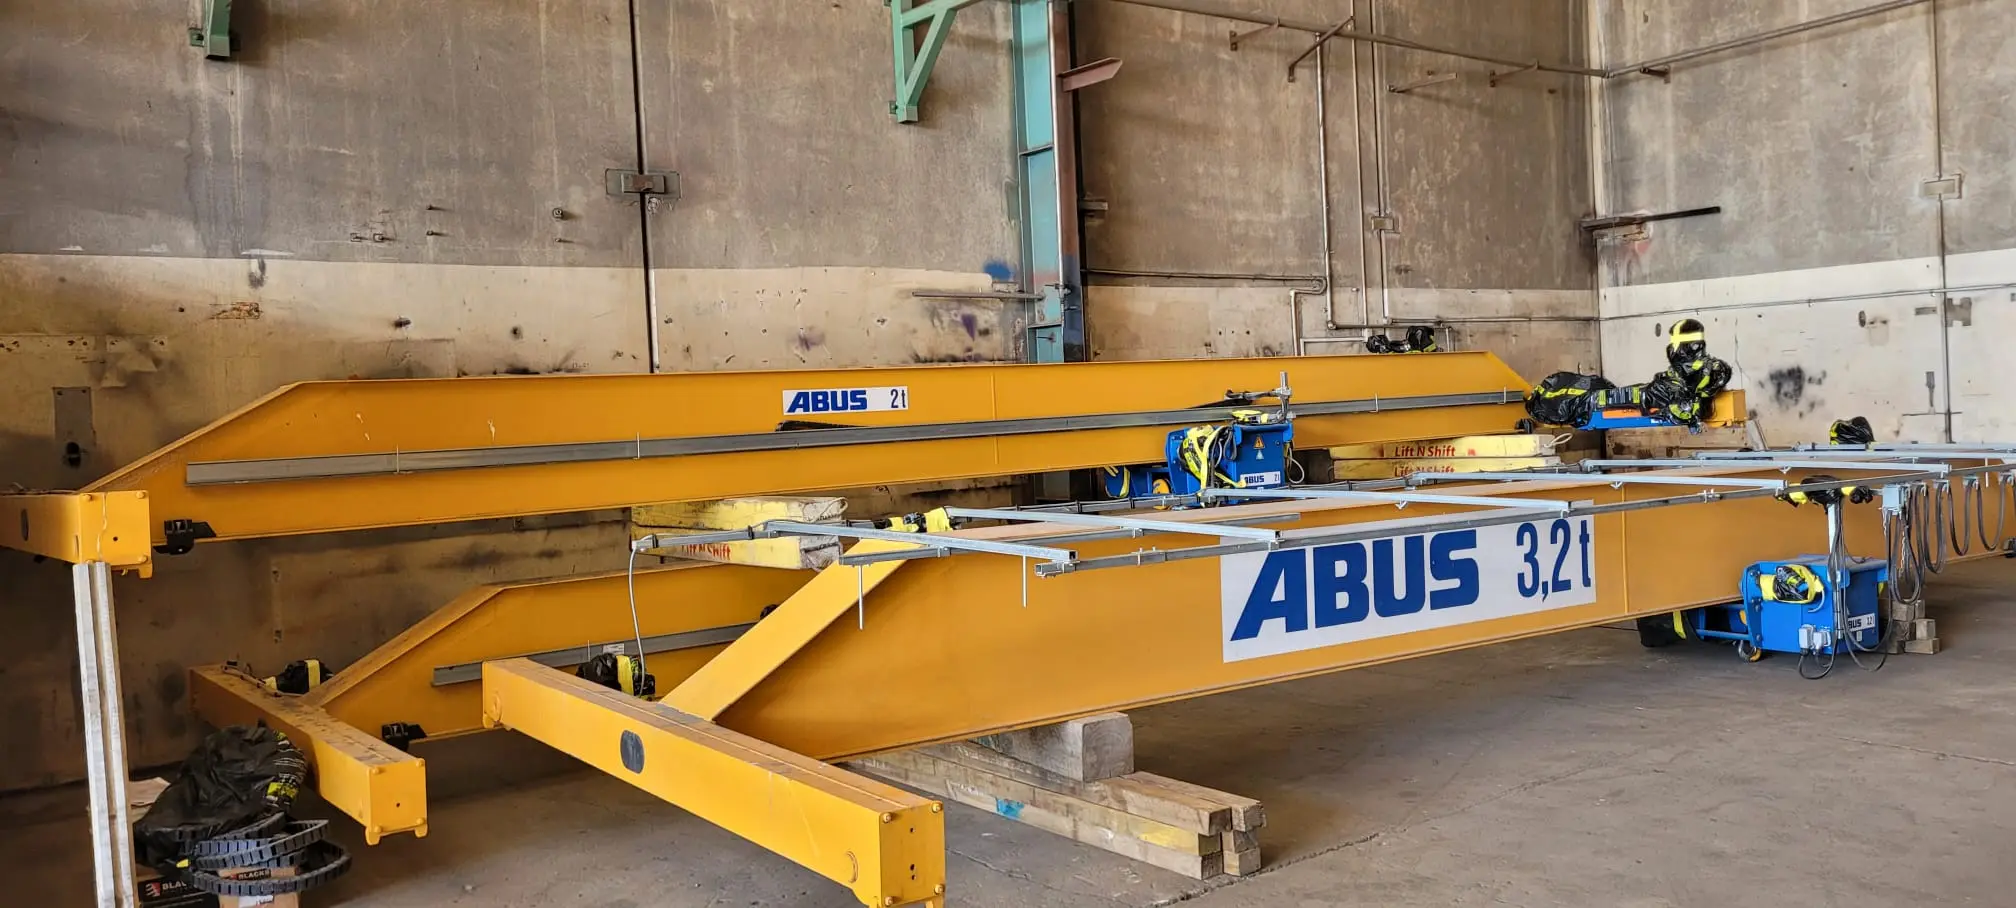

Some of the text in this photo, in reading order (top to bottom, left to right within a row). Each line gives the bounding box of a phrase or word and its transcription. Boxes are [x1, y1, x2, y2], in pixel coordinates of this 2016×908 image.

[786, 390, 868, 413] ABUS
[1395, 445, 1456, 457] Lift N Shift
[1230, 529, 1479, 641] ABUS
